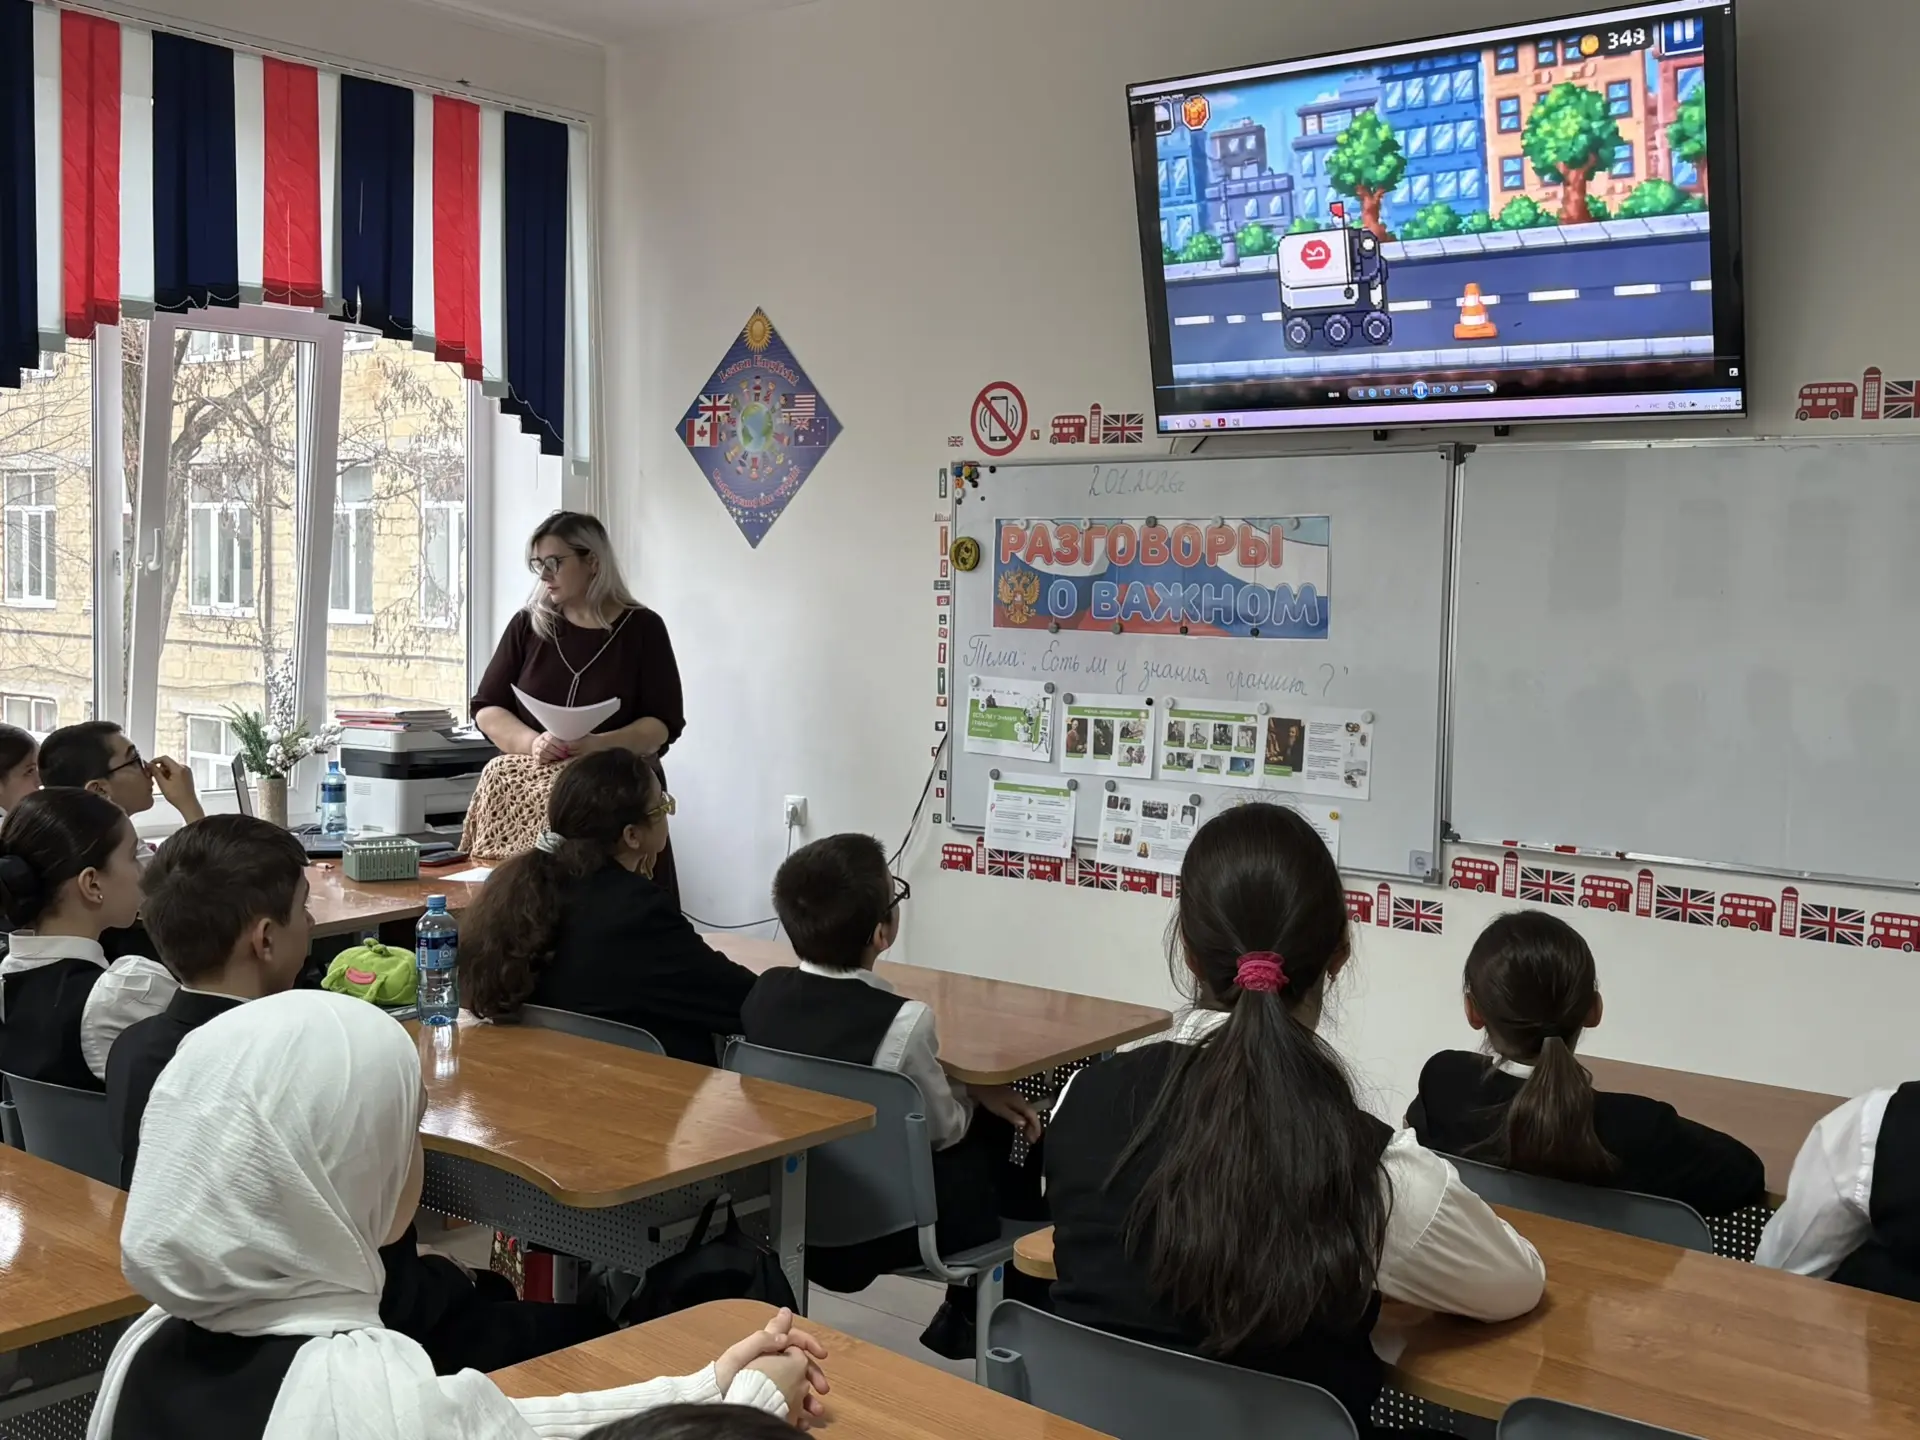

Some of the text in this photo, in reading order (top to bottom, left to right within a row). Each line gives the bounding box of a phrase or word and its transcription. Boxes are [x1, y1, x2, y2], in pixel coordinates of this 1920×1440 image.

[717, 358, 752, 384] Learn
[999, 523, 1284, 569] РАЗГОВОРЫ
[1047, 578, 1320, 627] О ВАЖНОМ
[963, 634, 1027, 667] Тема:
[1085, 656, 1107, 676] ли
[1115, 658, 1128, 694] у
[1137, 660, 1210, 693] знания
